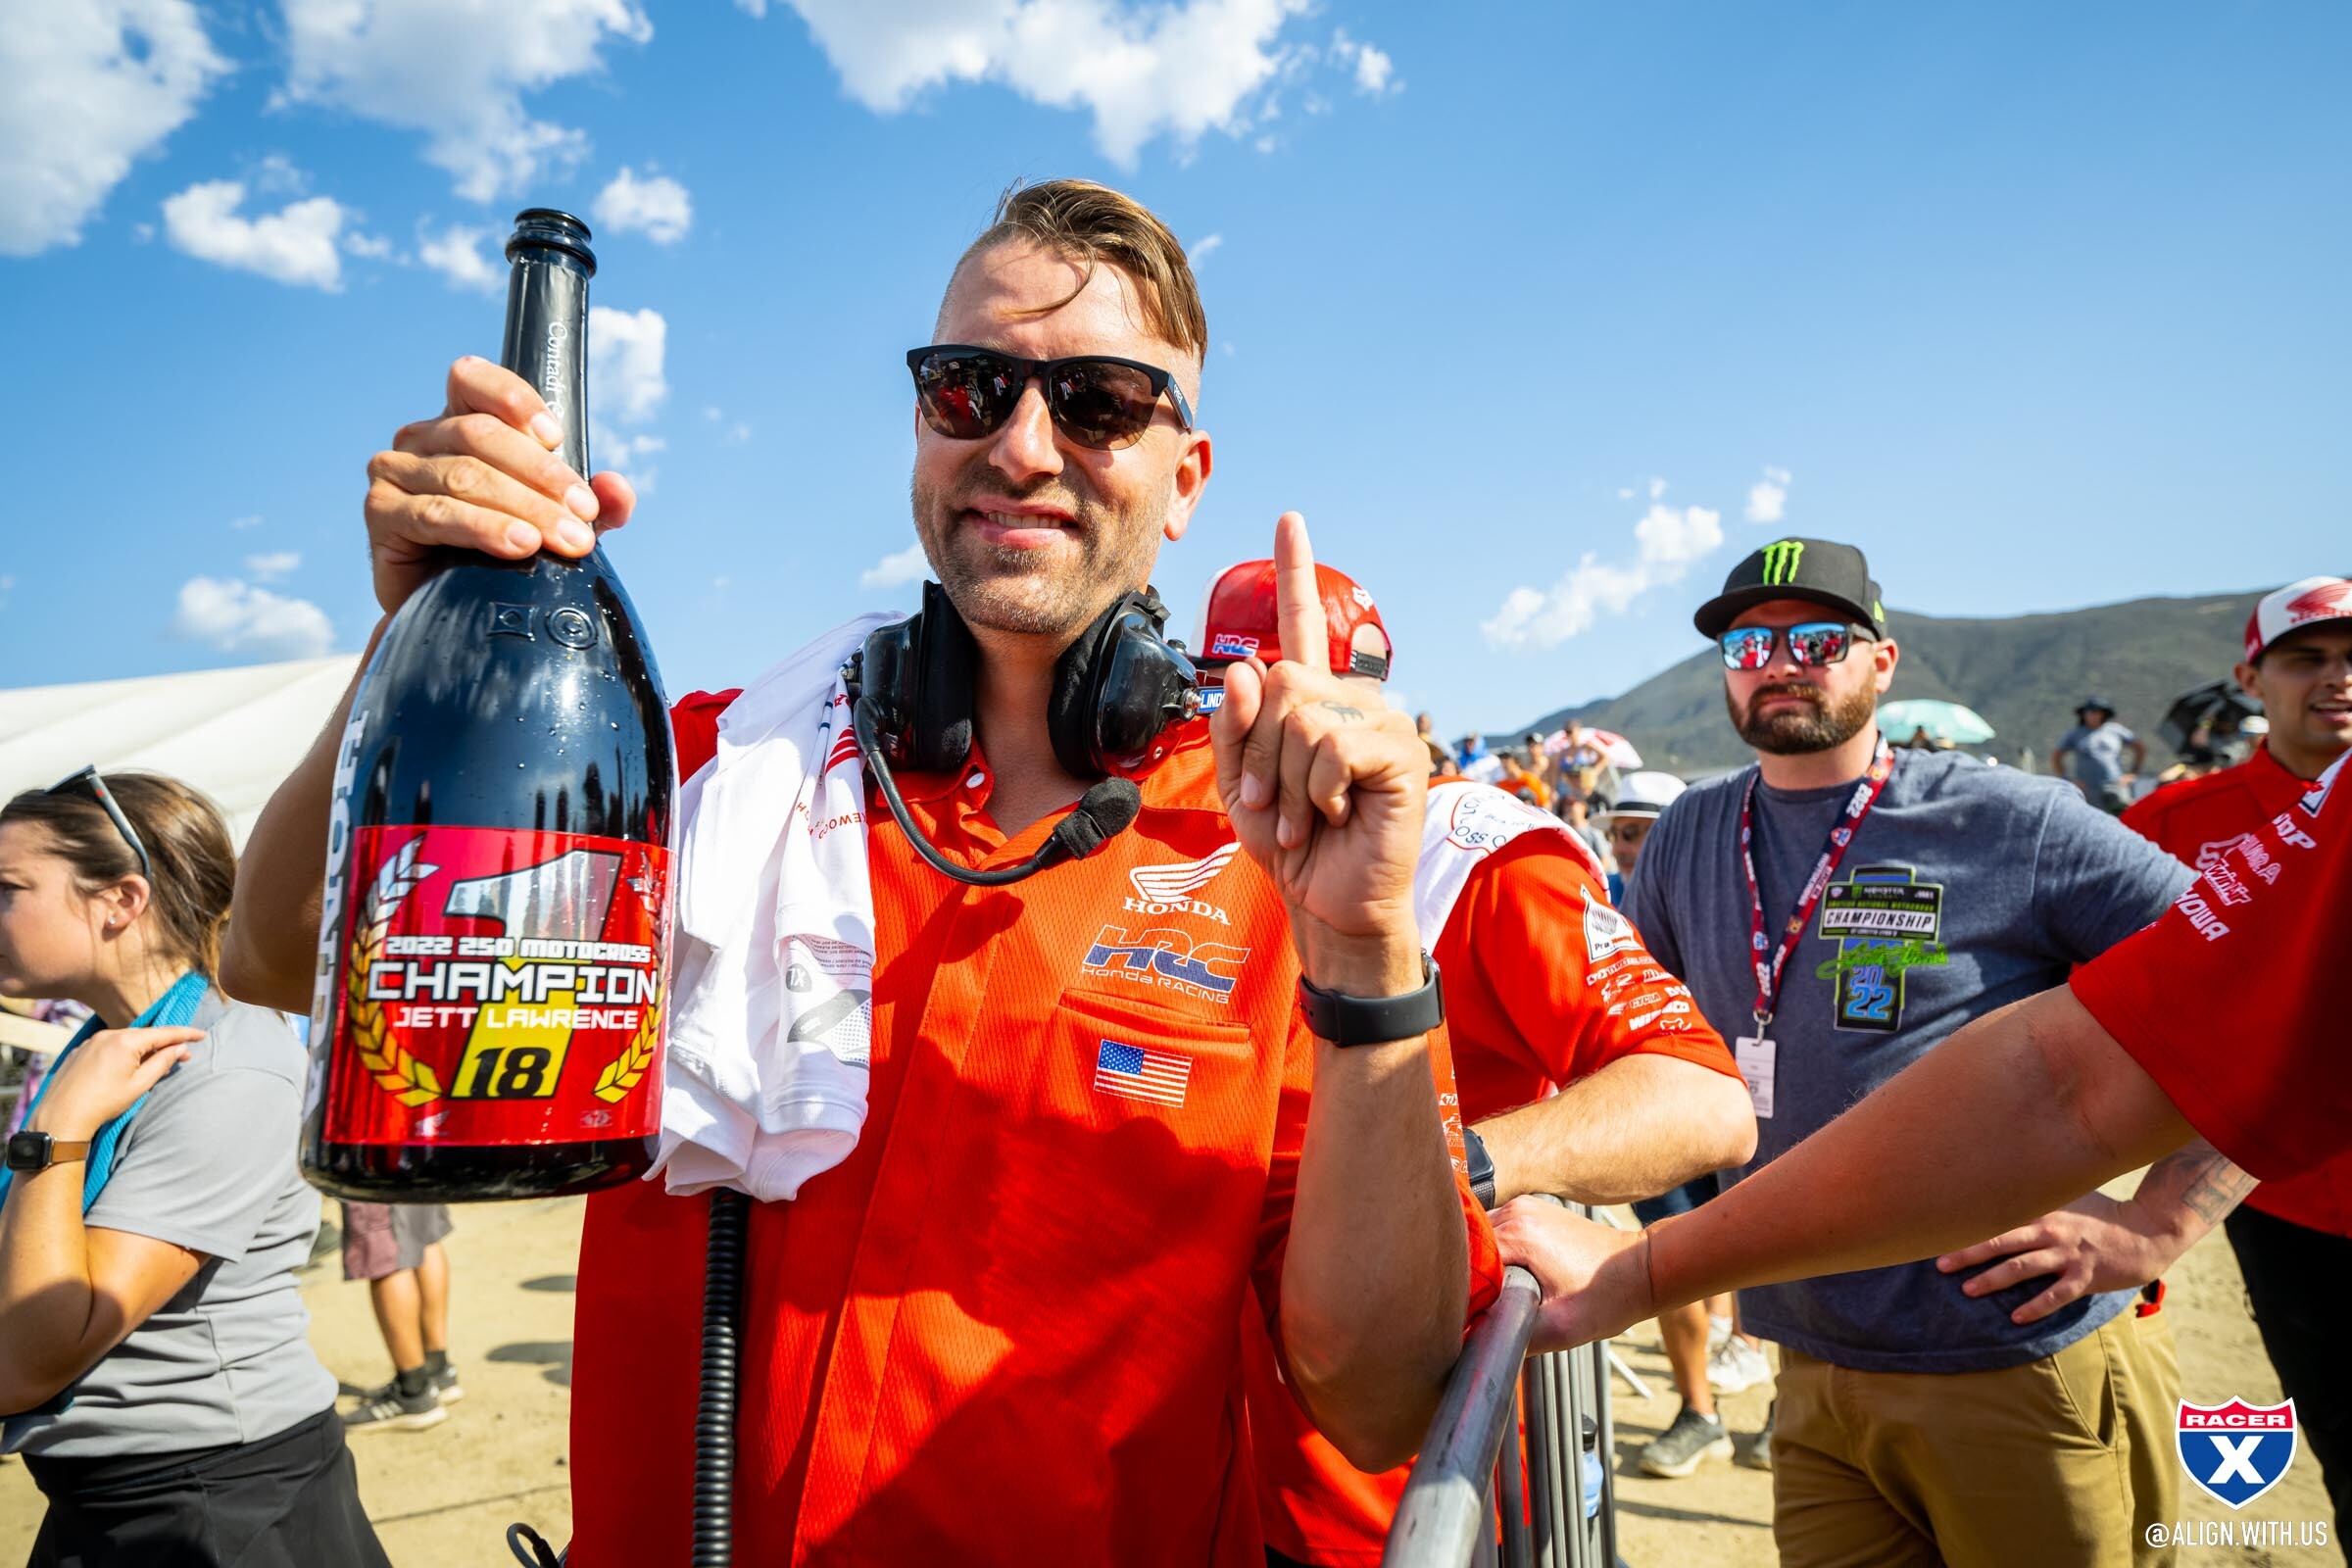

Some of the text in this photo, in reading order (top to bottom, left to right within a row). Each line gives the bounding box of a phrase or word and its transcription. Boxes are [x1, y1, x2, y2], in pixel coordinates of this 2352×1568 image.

[1122, 896, 1231, 925] HONDA
[1826, 910, 1933, 929] CHAMPIONSHIP
[385, 937, 652, 963] 2022 250 MOTOCROSS
[1082, 924, 1251, 994] HRC
[367, 961, 659, 1004] CHAMPION
[1081, 965, 1230, 1004] Honda RACING
[393, 1006, 639, 1030] JETT LAWRENCE
[1845, 986, 1893, 1019] 22
[472, 1046, 552, 1100] 18
